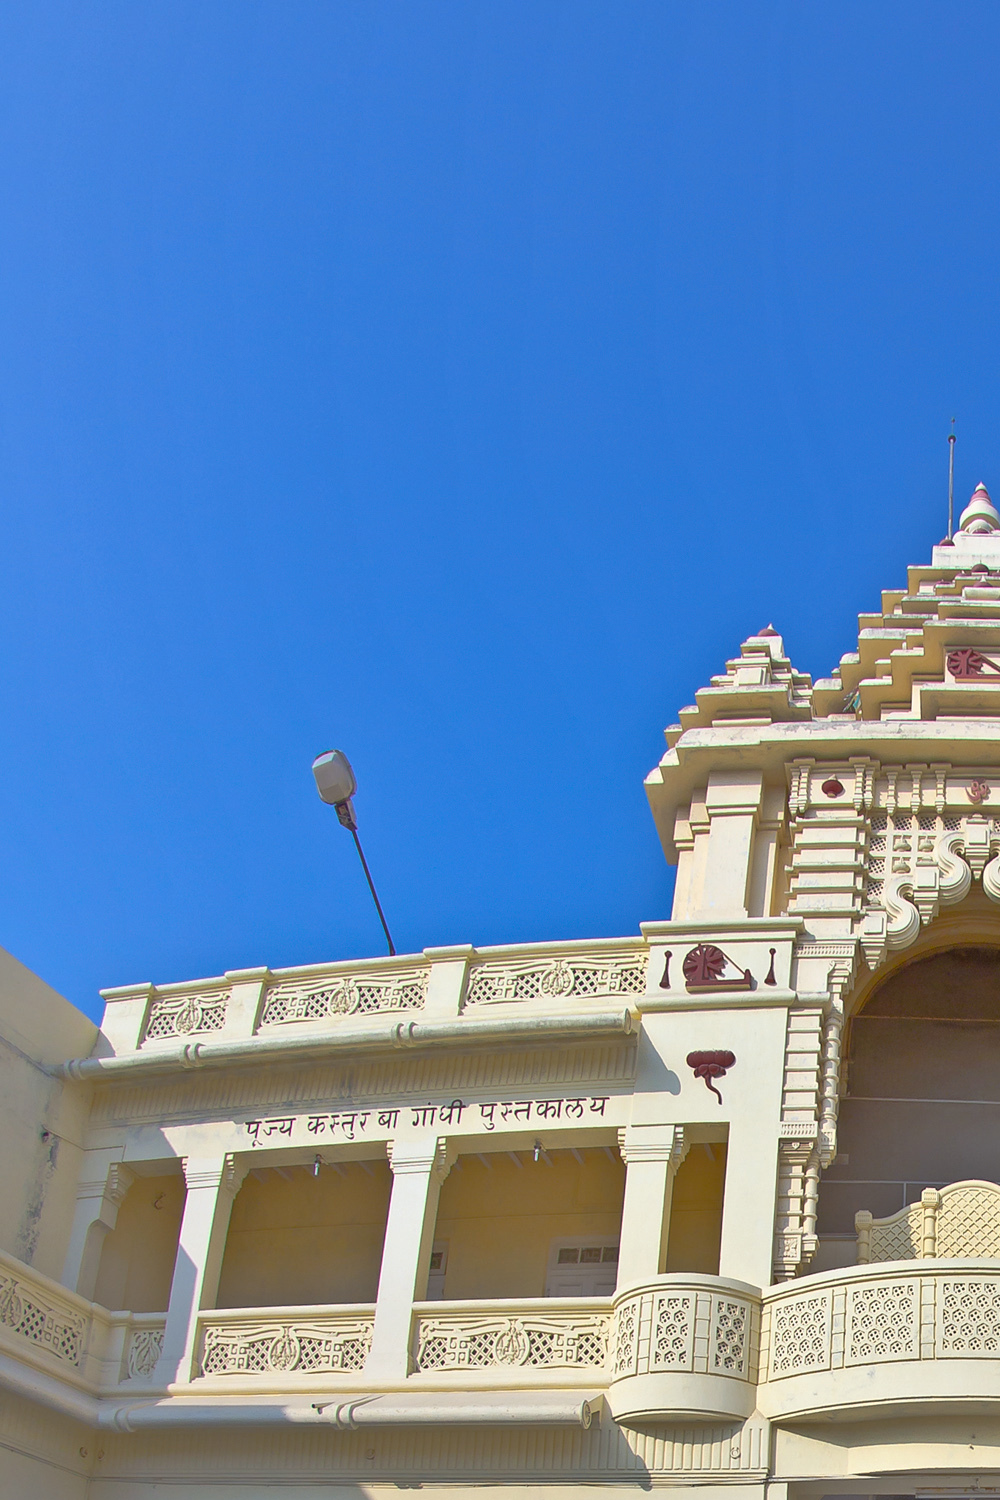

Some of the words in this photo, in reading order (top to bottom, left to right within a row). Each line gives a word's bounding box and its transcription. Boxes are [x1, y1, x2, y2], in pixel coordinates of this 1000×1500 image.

[245, 1115, 296, 1147] पूज्य
[411, 1098, 467, 1128] गांधी
[478, 1096, 610, 1130] पुस्तकालय
